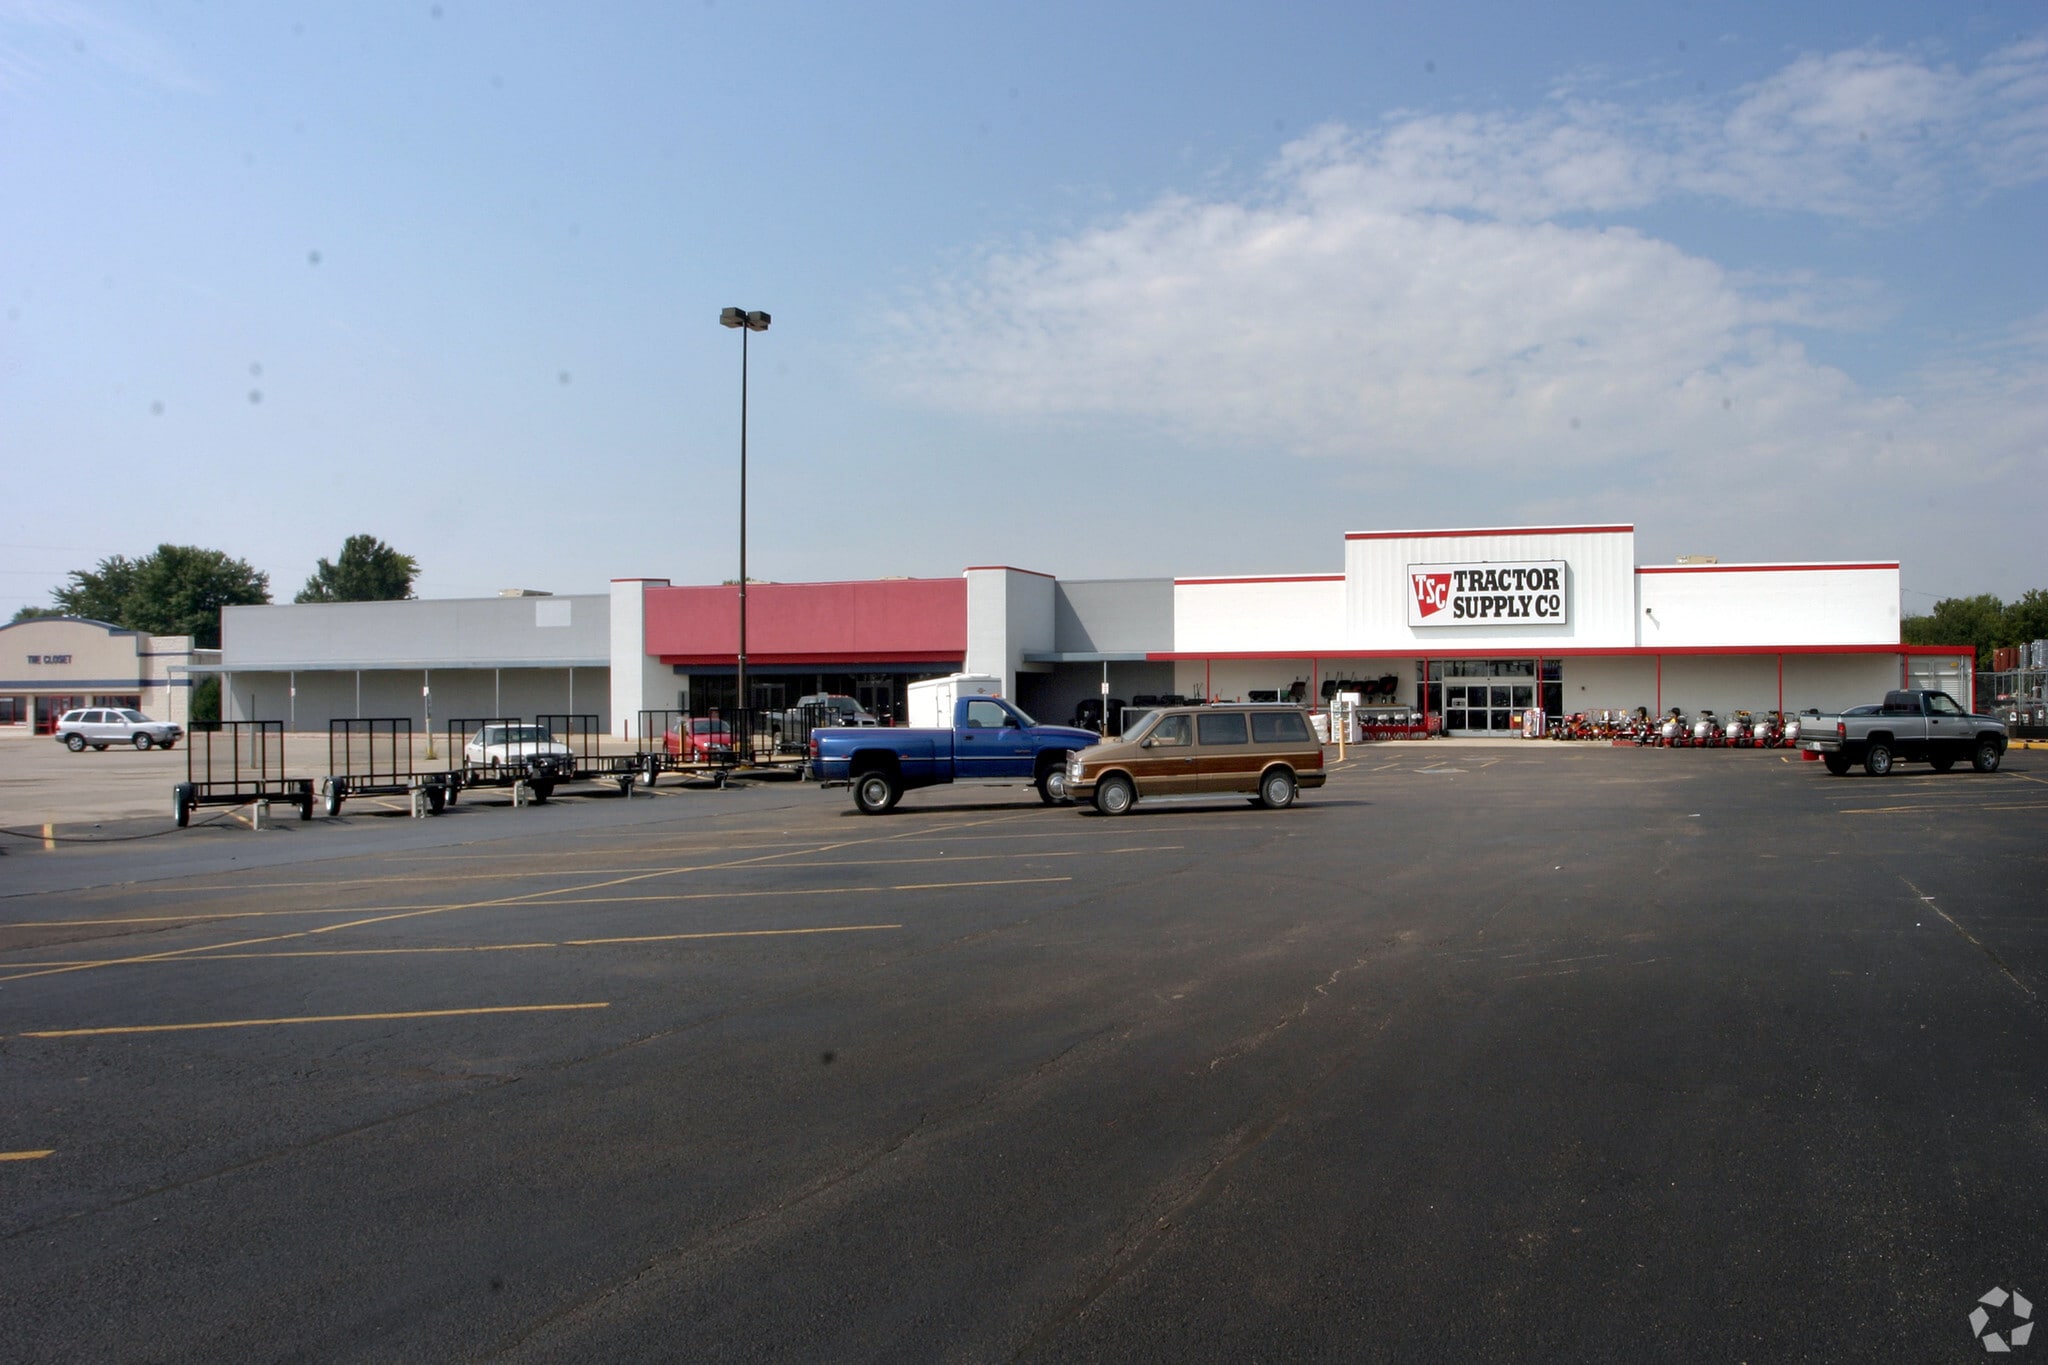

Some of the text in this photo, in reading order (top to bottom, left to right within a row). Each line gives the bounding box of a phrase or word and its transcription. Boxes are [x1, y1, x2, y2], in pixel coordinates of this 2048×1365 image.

[1415, 574, 1446, 609] TSC
[1453, 568, 1560, 592] TRACTOR
[1453, 595, 1533, 619] SUPPLY
